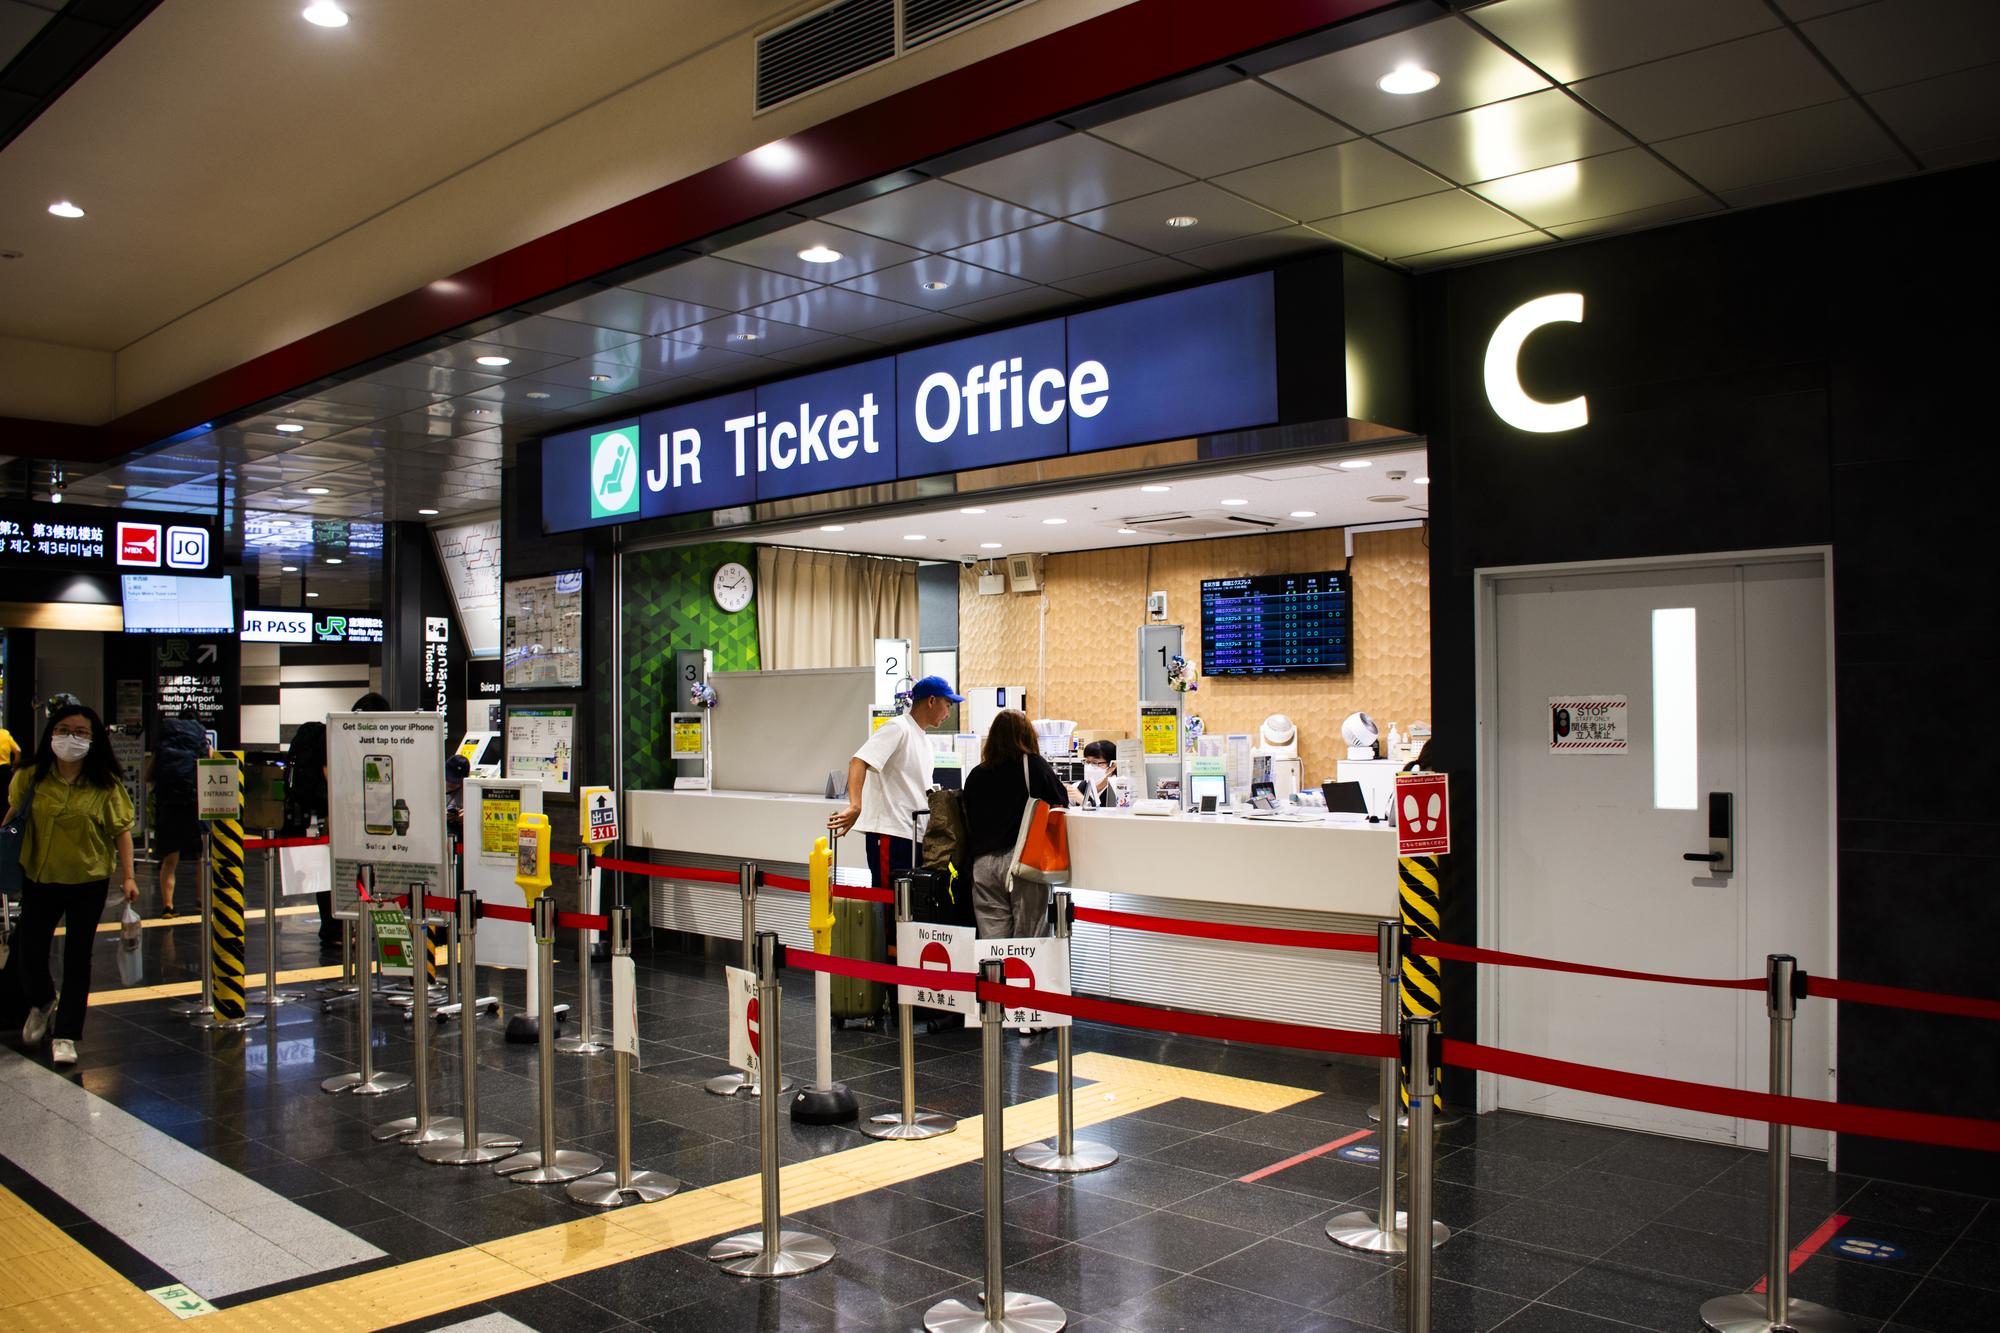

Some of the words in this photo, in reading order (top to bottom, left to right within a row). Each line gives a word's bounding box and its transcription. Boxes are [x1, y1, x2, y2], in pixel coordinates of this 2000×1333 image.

[1484, 292, 1588, 433] C
[646, 427, 702, 493] JR
[724, 391, 879, 477] Ticket
[915, 357, 1109, 443] Office
[176, 540, 200, 556] JO
[243, 619, 262, 632] JR
[267, 620, 306, 634] PASS
[1157, 645, 1167, 667] 1
[885, 656, 898, 675] 2
[685, 665, 697, 681] 3
[186, 695, 215, 704] Airport
[199, 703, 224, 711] Station
[1577, 706, 1608, 717] STOP
[342, 722, 355, 731] Get
[357, 722, 377, 731] Suica
[390, 724, 406, 732] your
[408, 723, 434, 731] iPhone
[1571, 722, 1616, 732] 関係者以外
[358, 736, 375, 744] Just
[376, 737, 389, 745] tap
[400, 736, 415, 744] ride
[1575, 730, 1611, 740] 立入禁止
[207, 774, 229, 785] 入口
[204, 790, 235, 798] ENTRANCE
[592, 810, 613, 824] 出口
[591, 826, 617, 839] EXIT
[919, 928, 930, 940] No
[932, 929, 953, 944] Entry
[991, 945, 1004, 956] No
[1008, 944, 1036, 957] Entry
[744, 979, 752, 994] No
[917, 990, 956, 1007] 進入禁止
